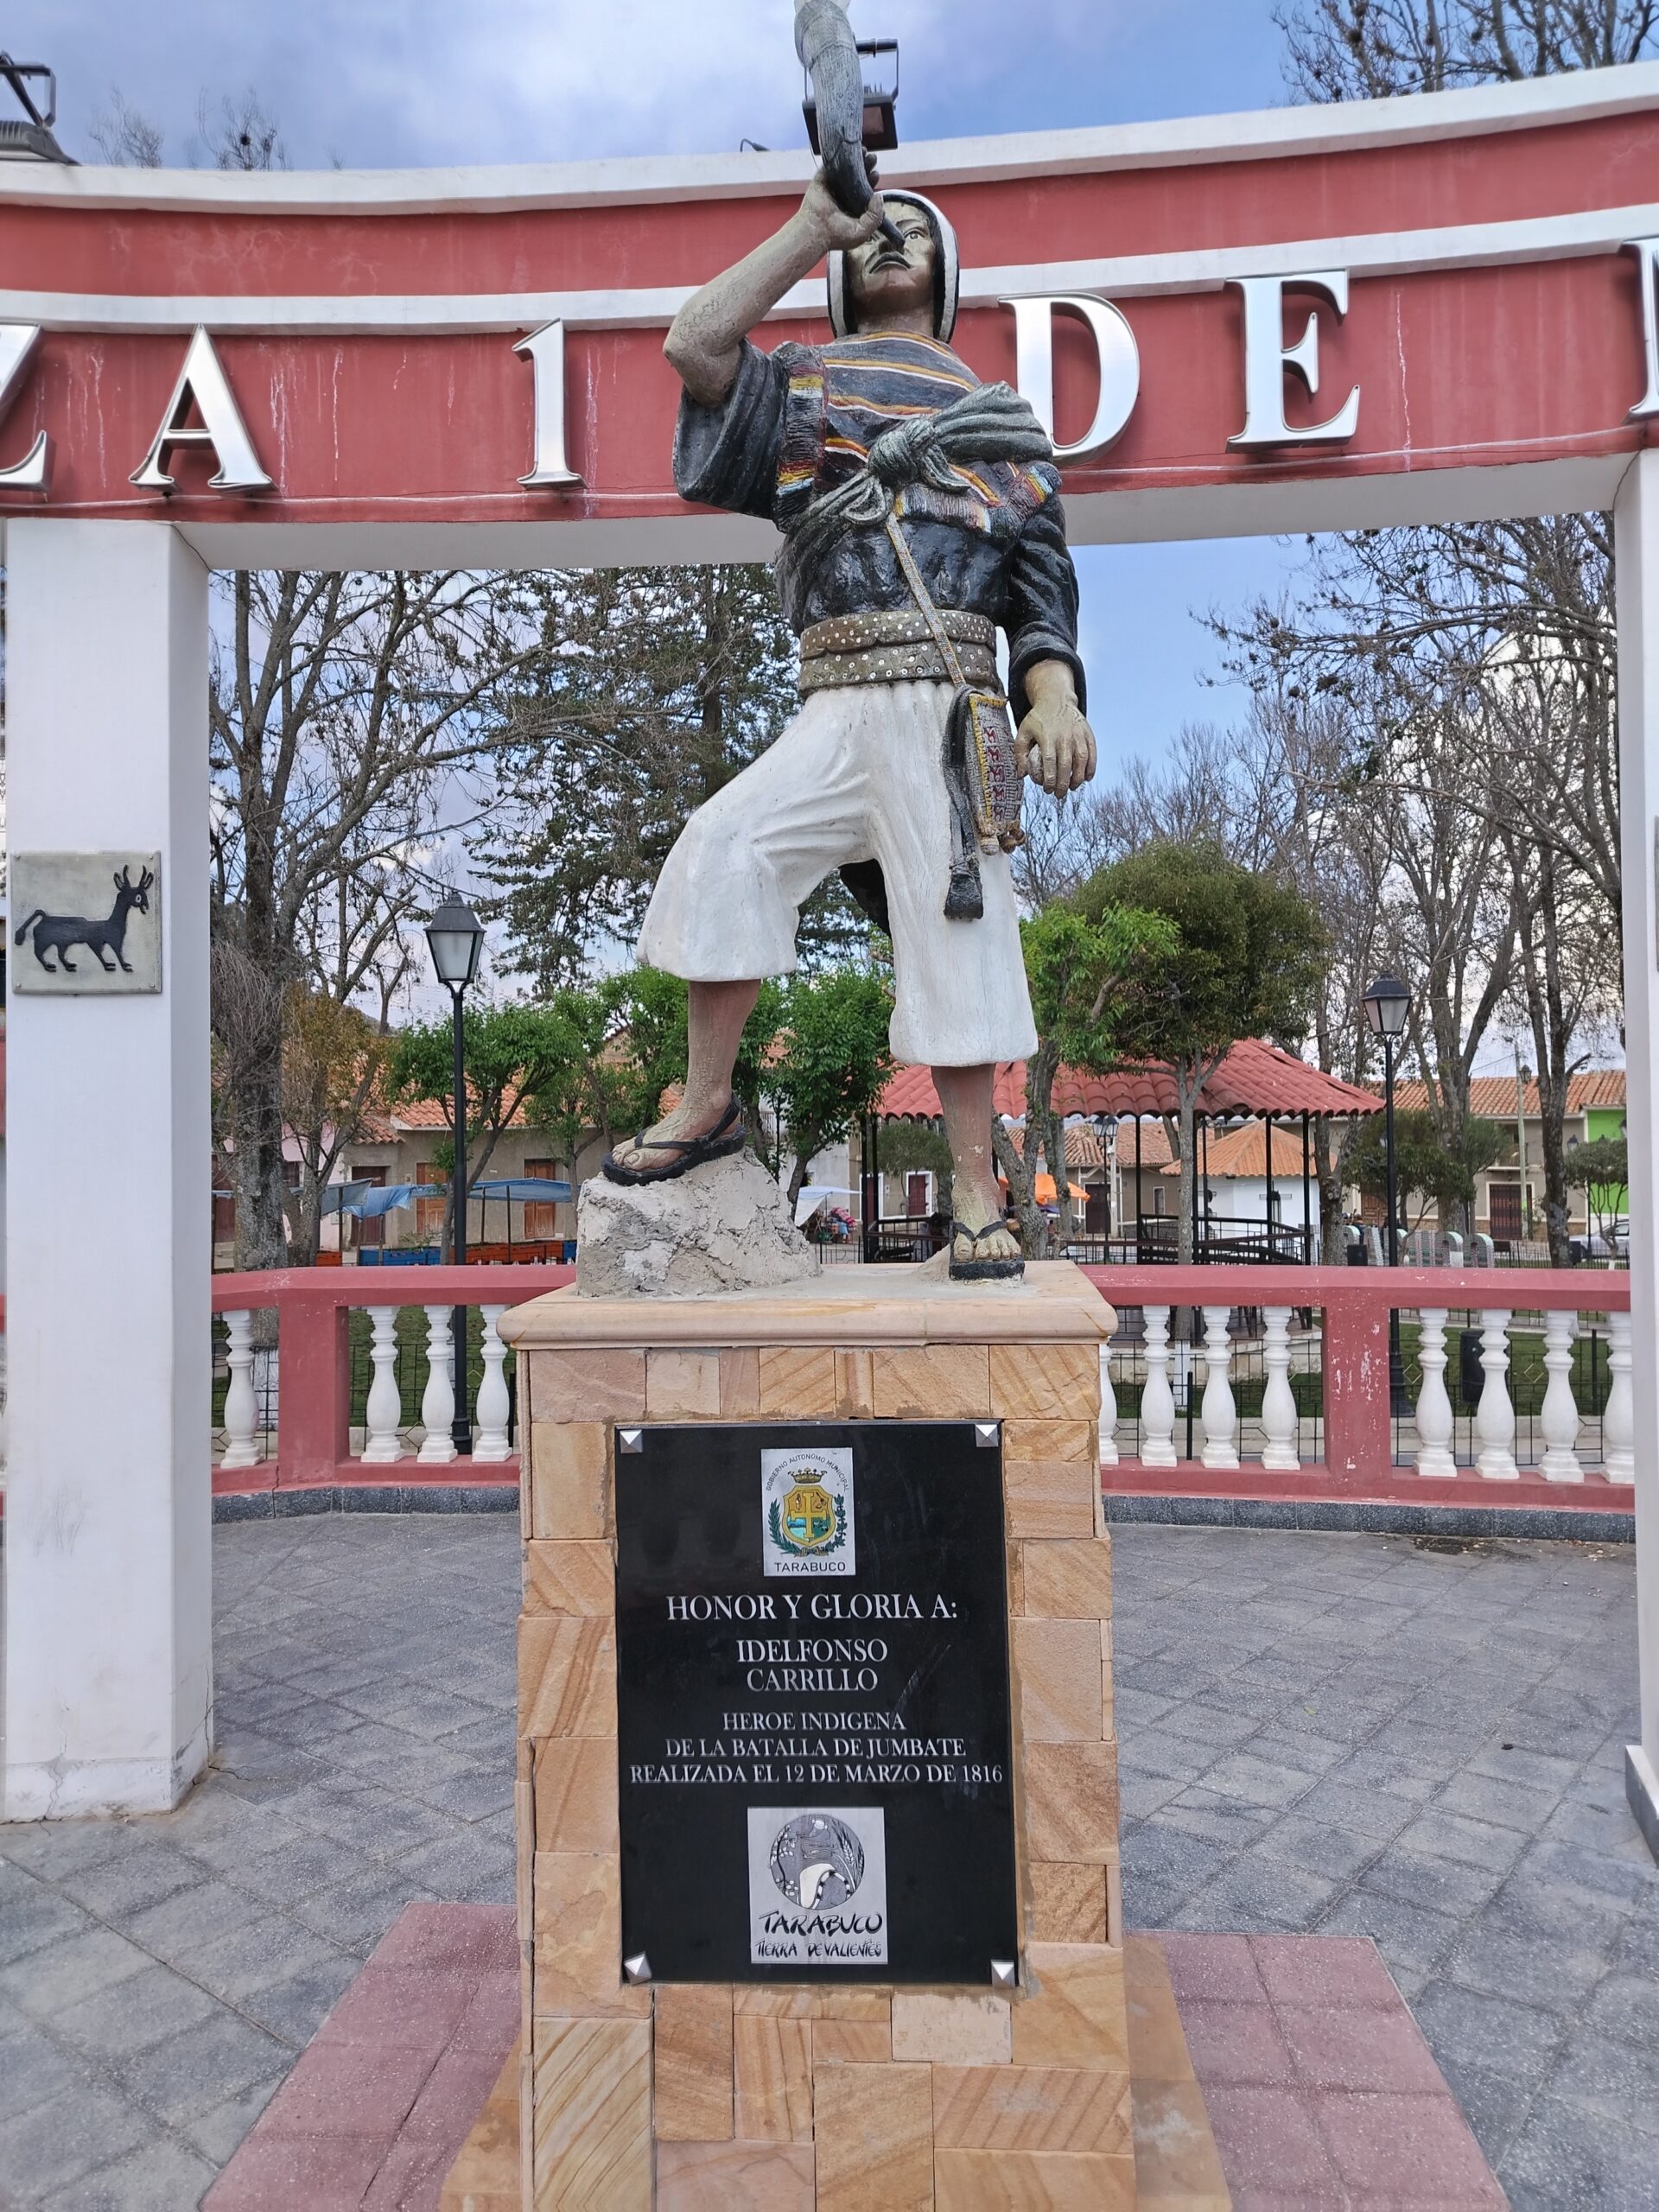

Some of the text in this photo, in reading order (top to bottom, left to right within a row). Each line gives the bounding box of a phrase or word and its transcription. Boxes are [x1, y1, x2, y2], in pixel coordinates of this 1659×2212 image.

[766, 1452, 849, 1492] GOBIERNO AUTONOMO MUNICIPAL
[774, 1561, 846, 1573] TARABUCO
[666, 1593, 957, 1621] HONOR Y GLORIA A:
[735, 1638, 888, 1662] IDELFONSO
[746, 1668, 879, 1692] CARRILLO
[722, 1712, 907, 1732] HEROE INDIGENA
[664, 1738, 967, 1759] DE LA BATALLA DE JUMBATE
[629, 1764, 1002, 1783] REALIZADA EL 12 DE MARZO DE 1816
[758, 1910, 883, 1937] TARABUCO
[754, 1938, 882, 1958] TIERRA DE VALIENTES
